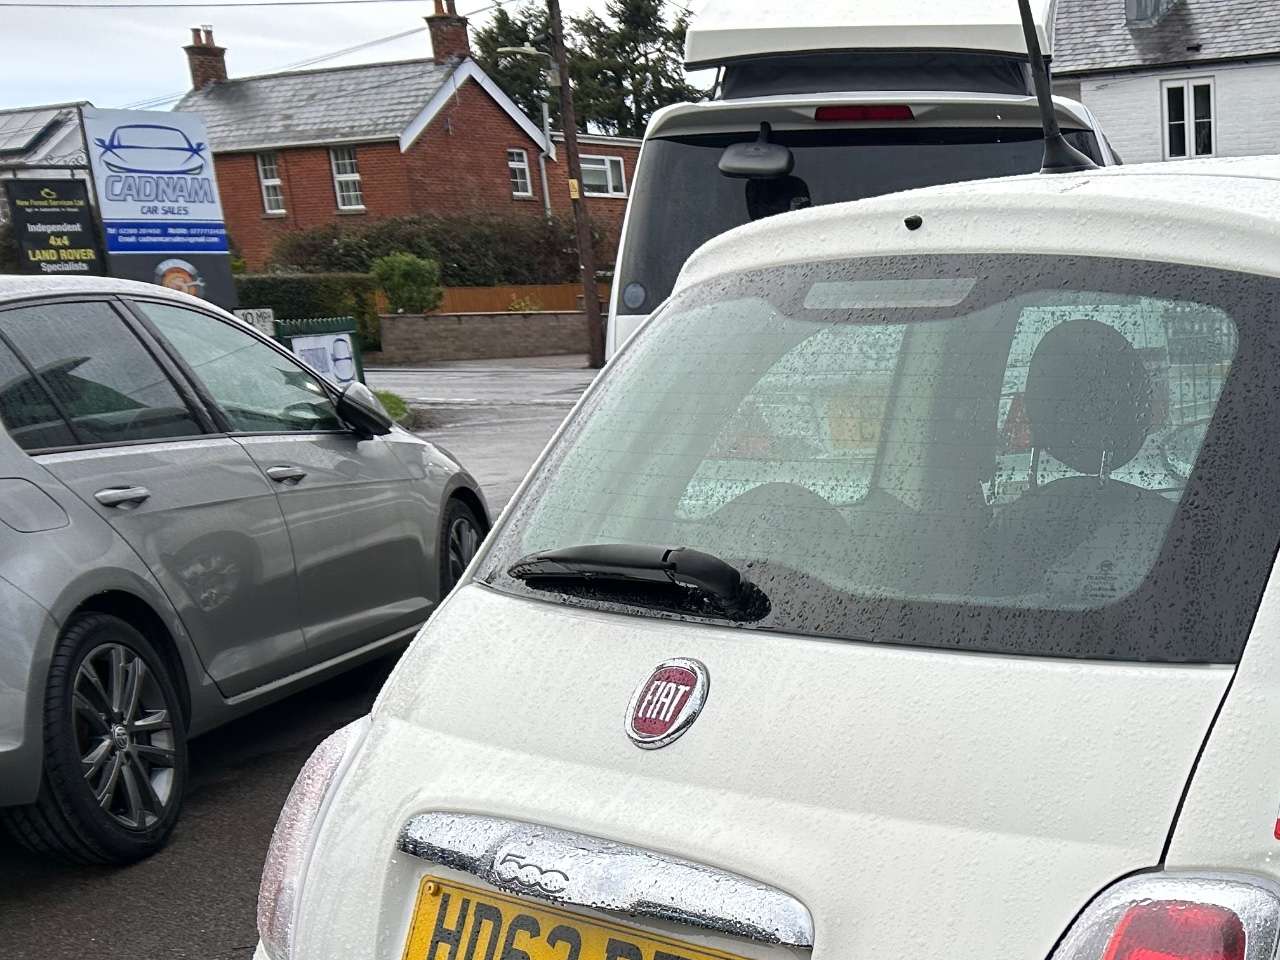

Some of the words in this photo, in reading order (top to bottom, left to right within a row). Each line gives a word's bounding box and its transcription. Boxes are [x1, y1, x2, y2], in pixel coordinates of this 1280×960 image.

[105, 174, 216, 203] CADNAM
[140, 205, 159, 215] CAR
[161, 206, 189, 215] SALES
[27, 223, 82, 233] Independent
[49, 235, 69, 246] 4x4
[28, 249, 57, 261] LAND
[59, 248, 96, 260] ROVER
[41, 262, 88, 272] Specialists
[638, 680, 690, 722] FIAT
[499, 853, 570, 894] 500
